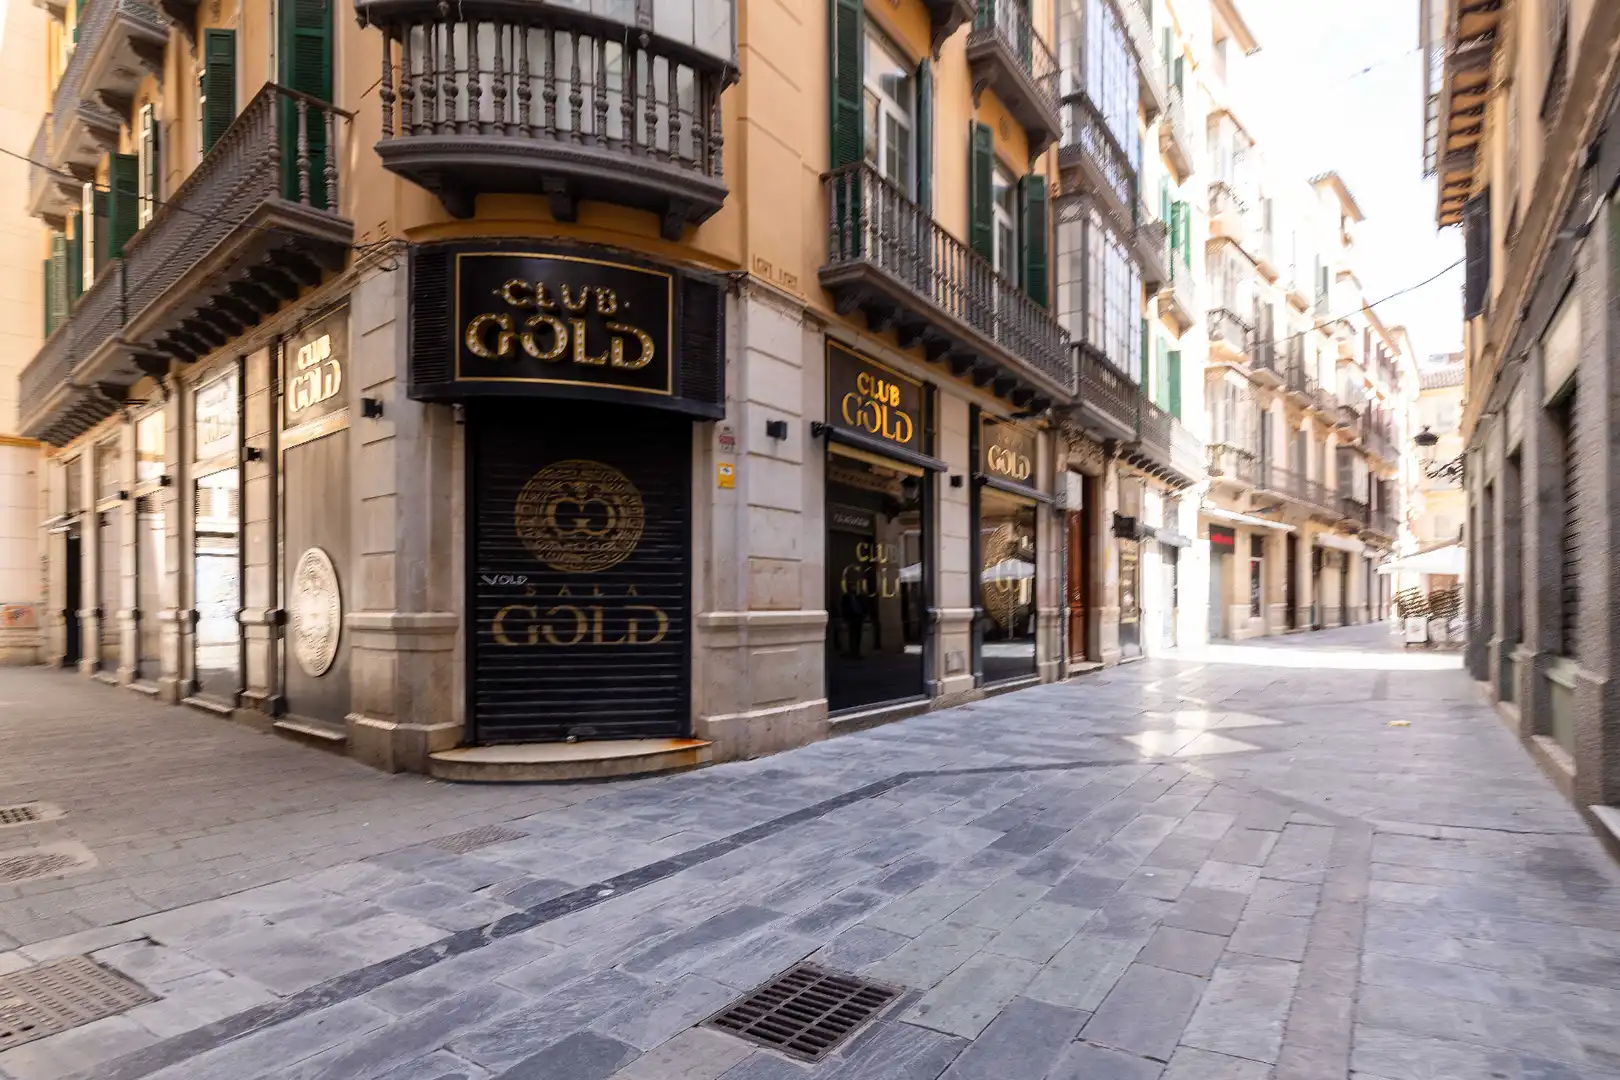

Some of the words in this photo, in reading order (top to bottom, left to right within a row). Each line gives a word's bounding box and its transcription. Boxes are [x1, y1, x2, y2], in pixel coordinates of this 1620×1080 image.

[500, 278, 618, 315] CLUB
[465, 312, 656, 371] GOLD
[289, 359, 341, 412] GOLD
[856, 371, 900, 407] CLUB
[841, 392, 913, 443] GOLD
[987, 444, 1031, 480] GOLD
[491, 604, 669, 646] GOLD
